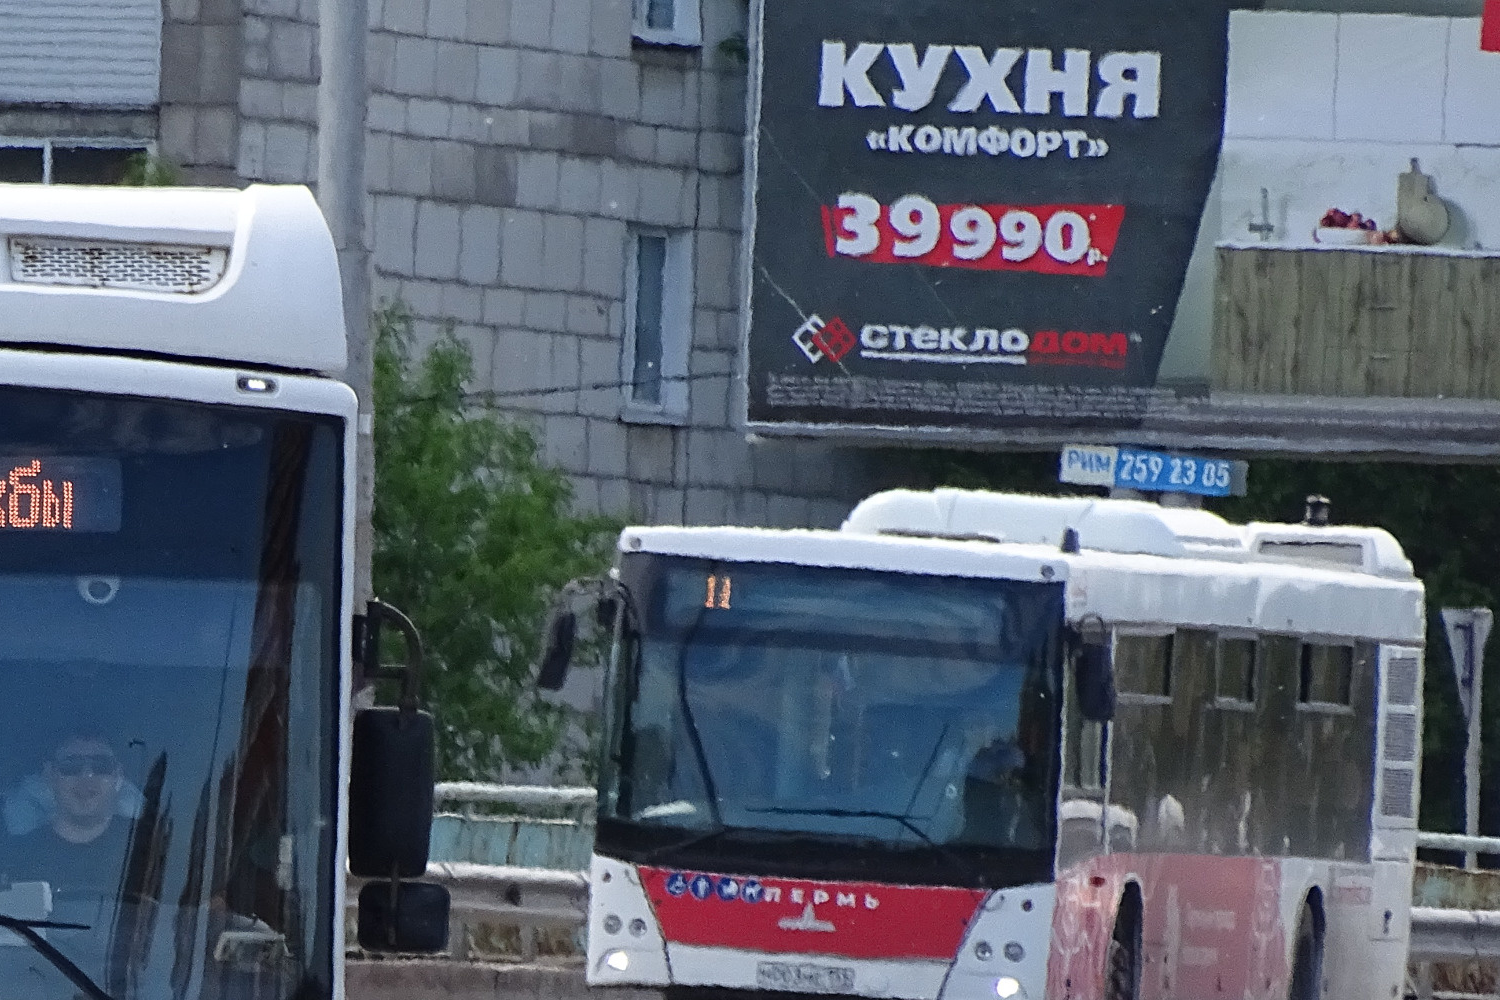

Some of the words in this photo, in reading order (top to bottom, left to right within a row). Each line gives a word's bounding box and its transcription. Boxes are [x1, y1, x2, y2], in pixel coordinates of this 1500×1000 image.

[818, 39, 1162, 119] КУХНЯ
[866, 125, 1110, 158] «КОМФОРТ»
[1120, 452, 1164, 483] 259
[1169, 458, 1198, 486] 23
[1202, 461, 1232, 488] 05
